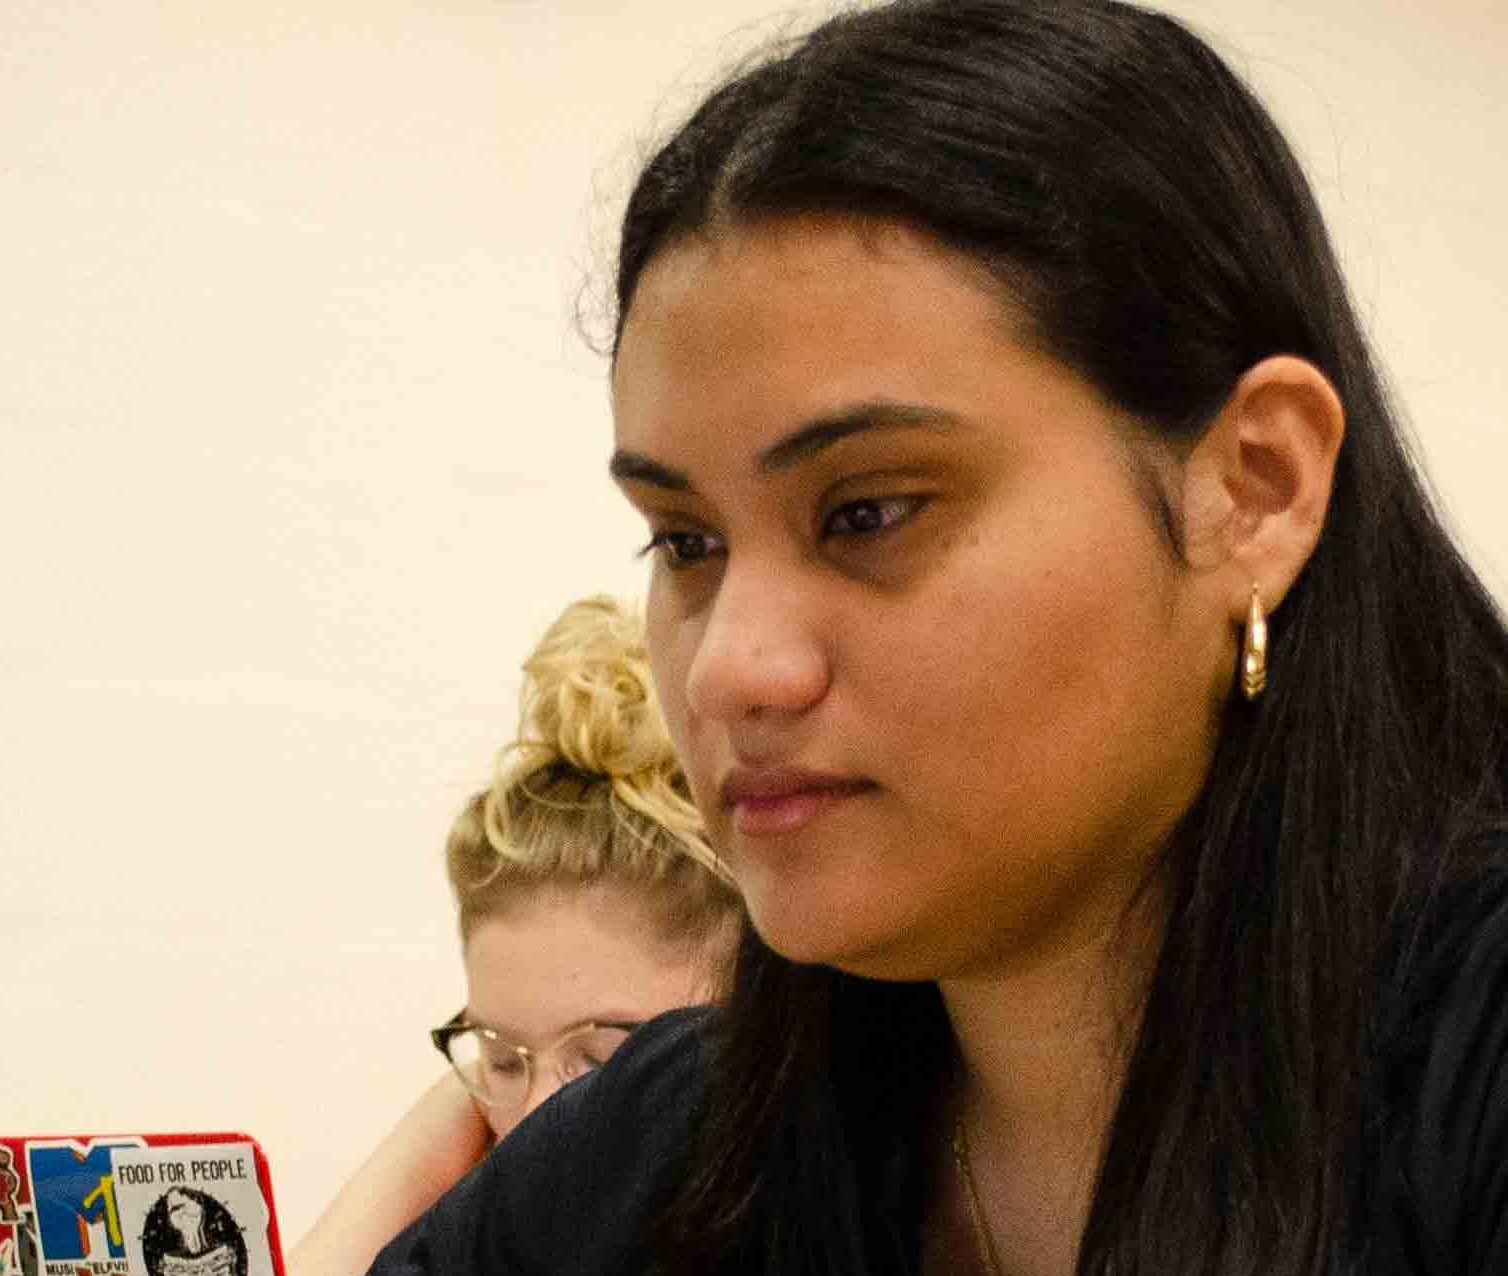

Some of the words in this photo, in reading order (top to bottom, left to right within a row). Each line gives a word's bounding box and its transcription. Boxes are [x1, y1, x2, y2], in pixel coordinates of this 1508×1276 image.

[118, 1163, 154, 1185] FOOD
[158, 1161, 187, 1183] FOR
[191, 1157, 247, 1182] PEOPLE
